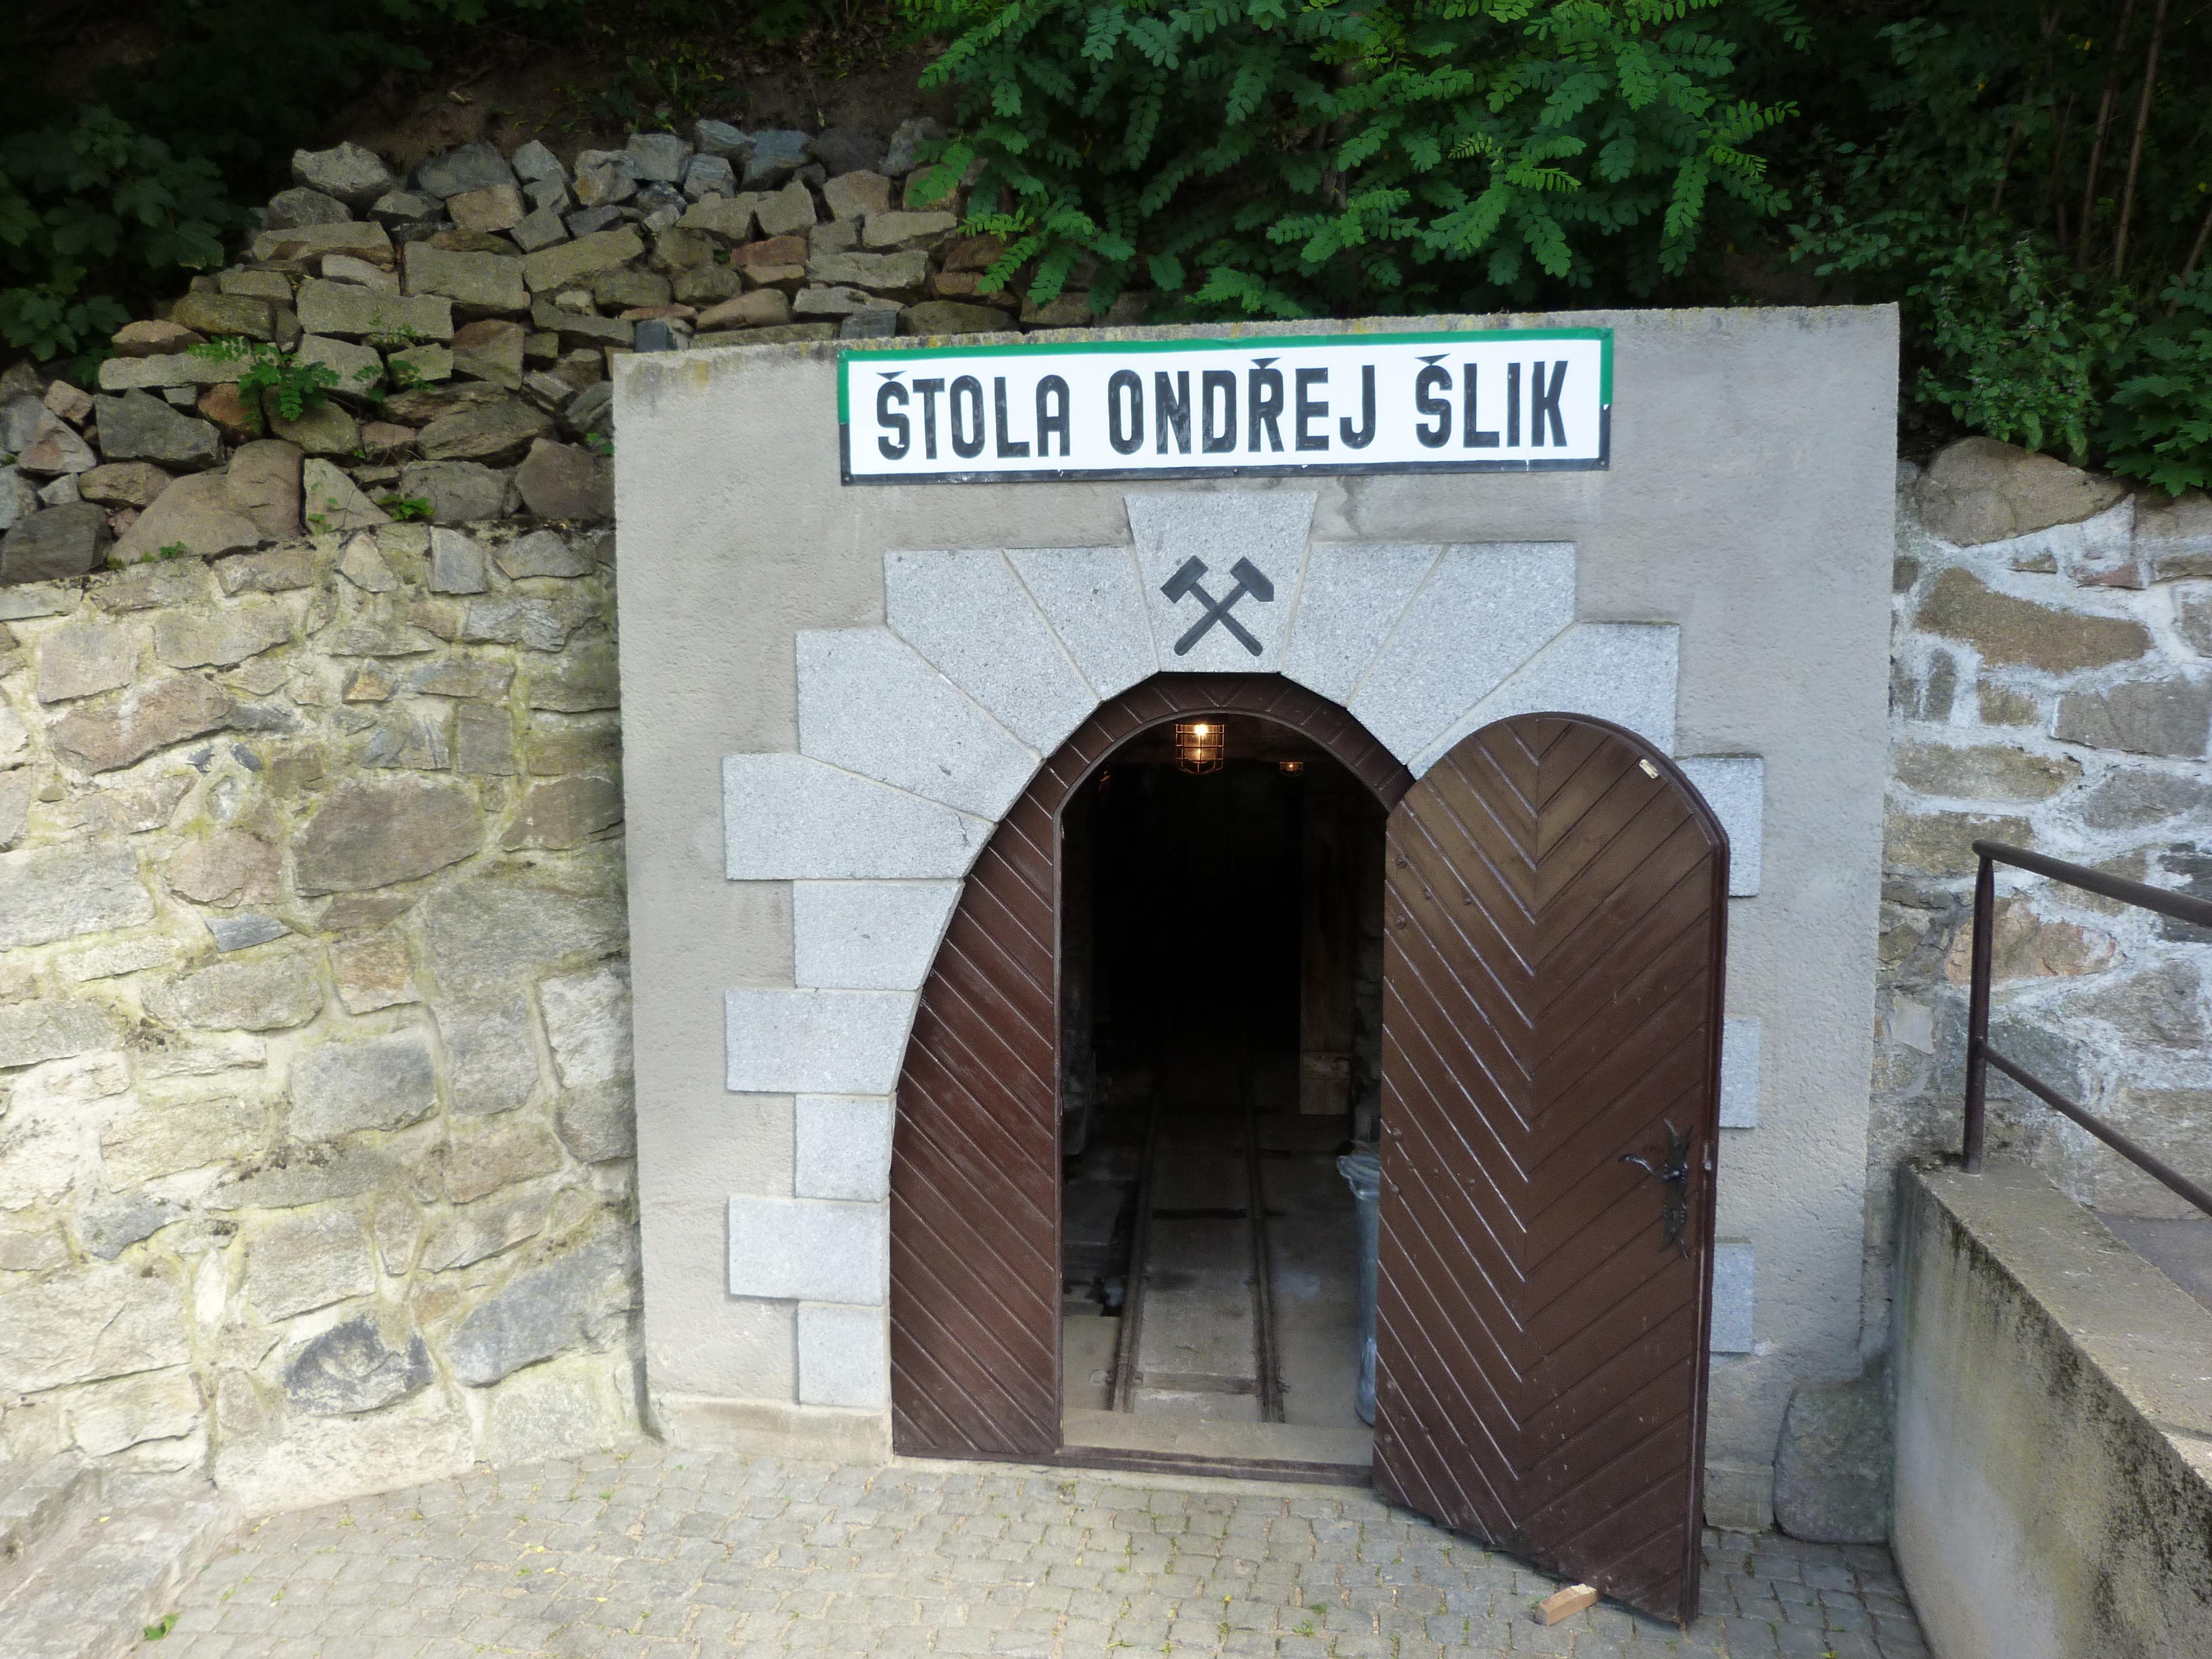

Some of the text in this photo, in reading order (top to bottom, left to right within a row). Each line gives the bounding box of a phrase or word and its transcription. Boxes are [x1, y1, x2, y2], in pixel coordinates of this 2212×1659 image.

[876, 353, 1568, 460] ŠTOLA ONDŘEJ ŠLIK
